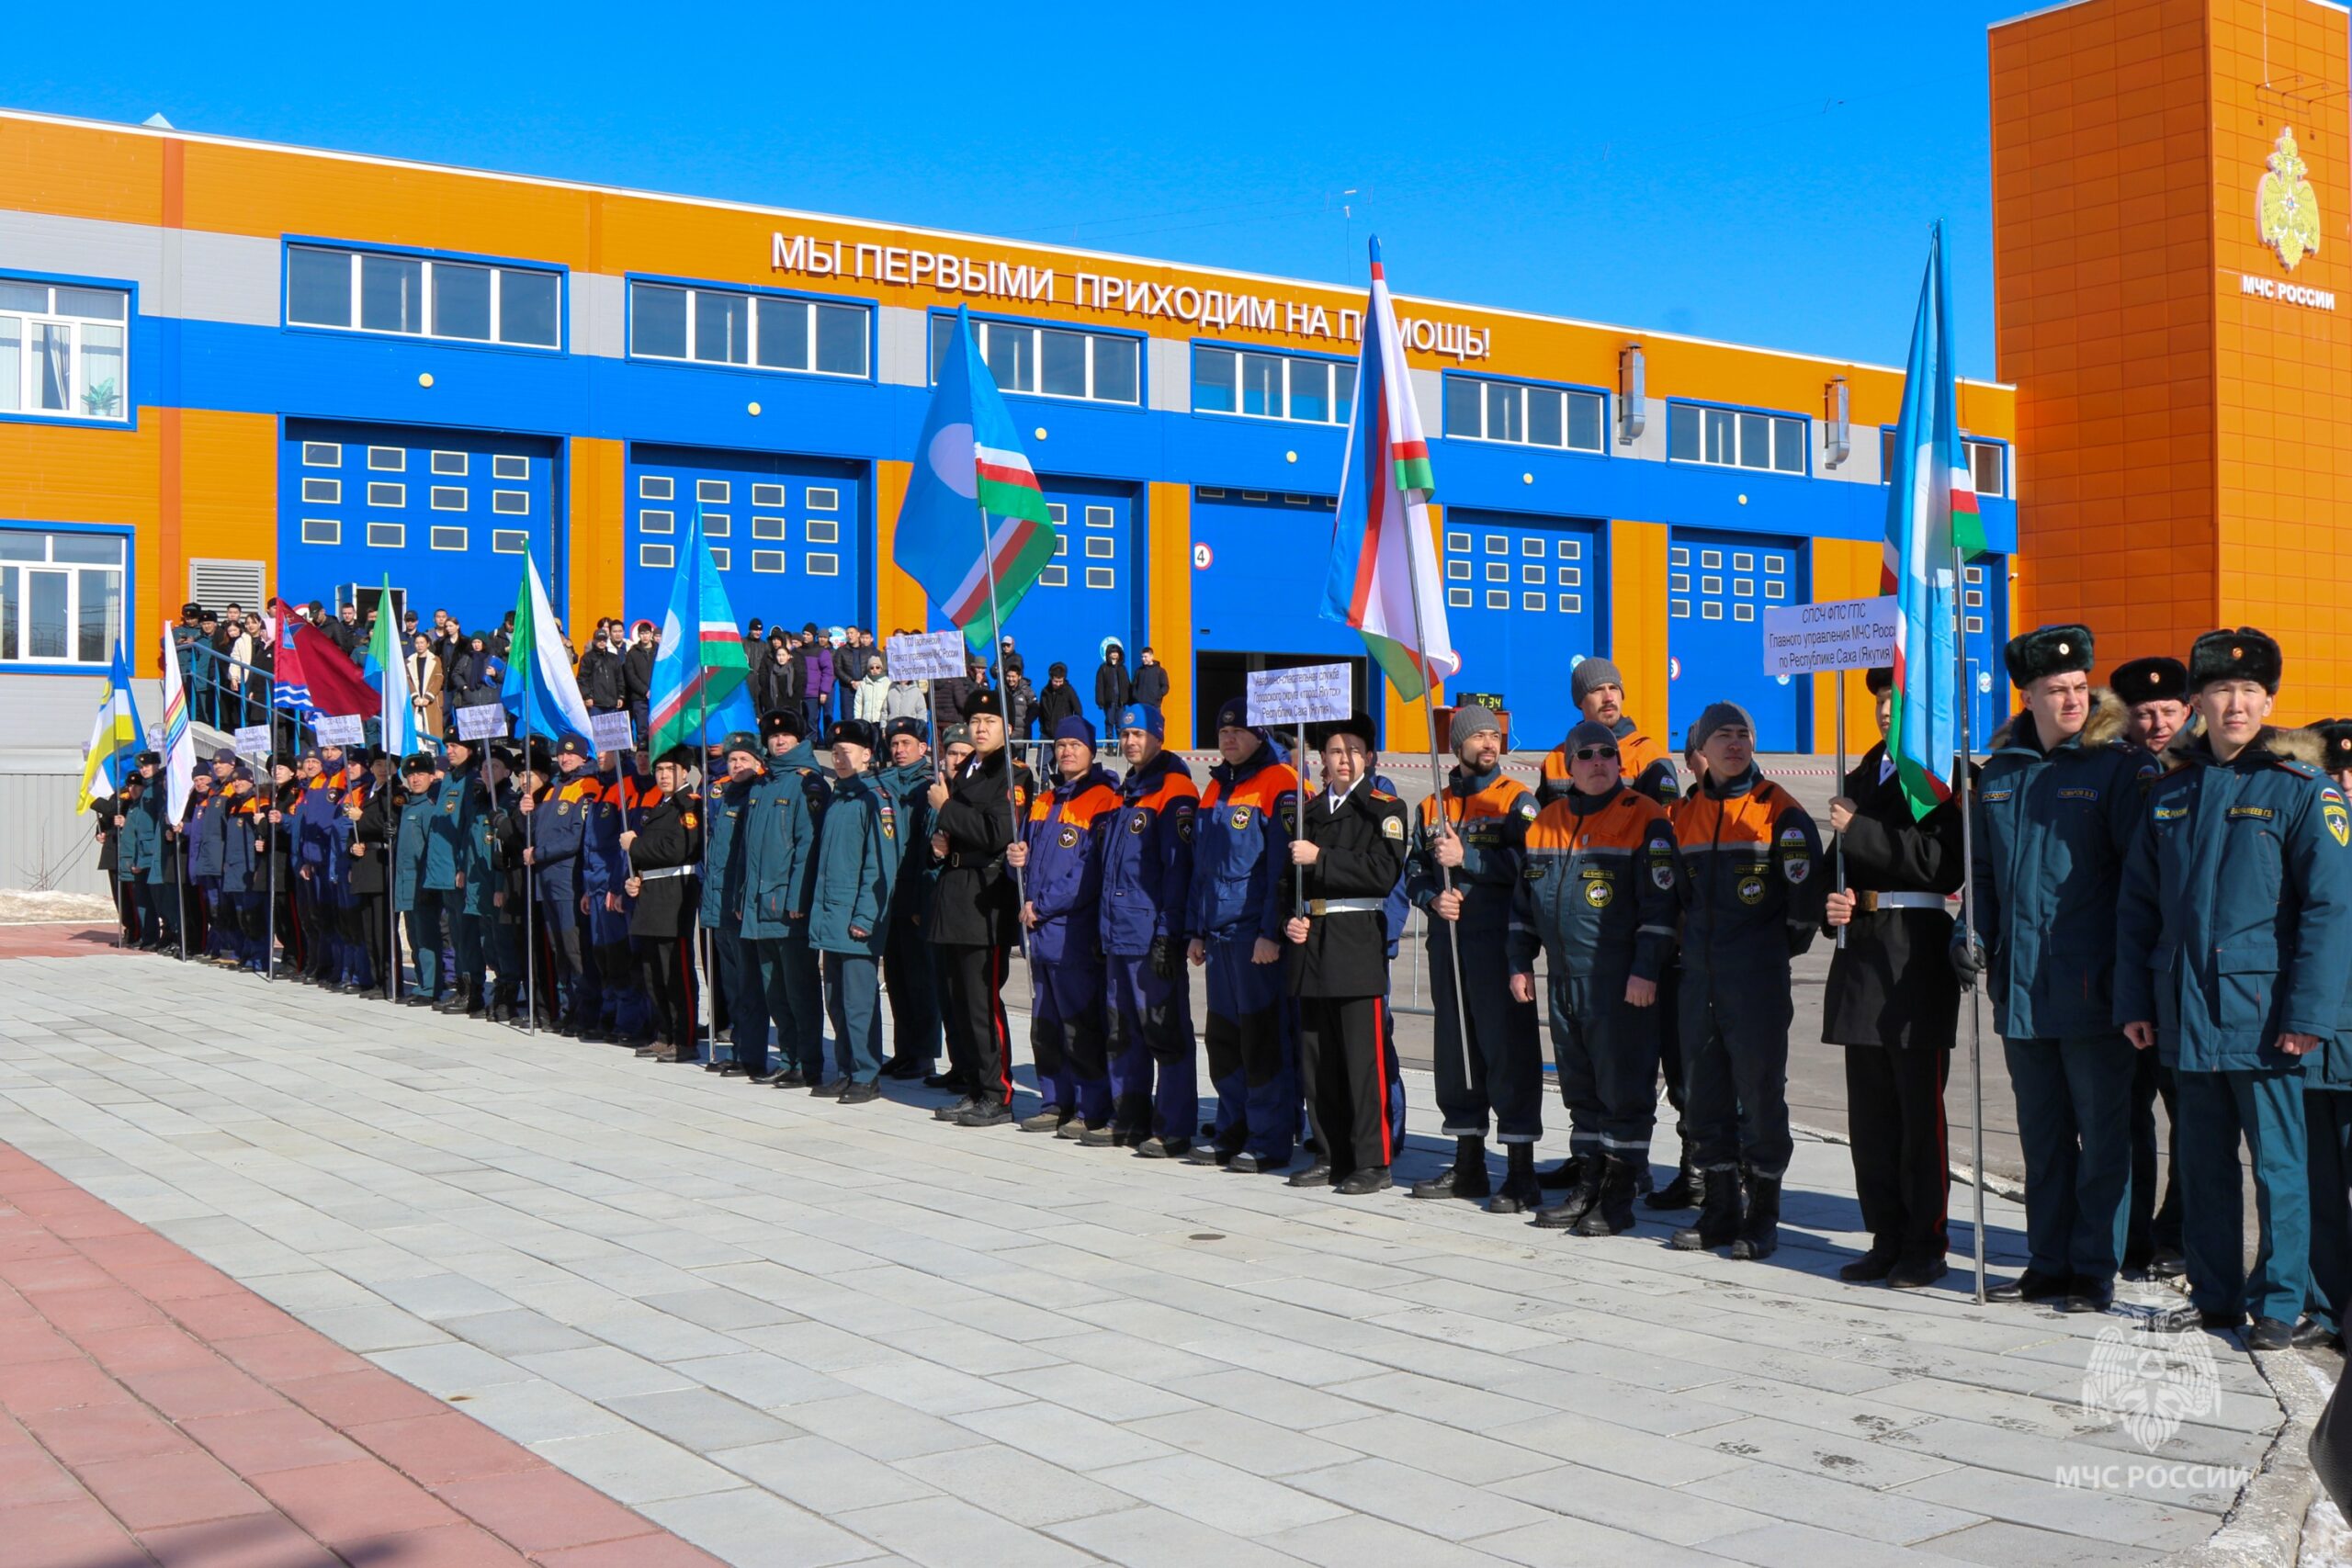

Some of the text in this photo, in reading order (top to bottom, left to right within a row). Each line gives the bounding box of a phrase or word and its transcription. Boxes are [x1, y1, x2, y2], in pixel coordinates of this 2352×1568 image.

[772, 232, 842, 276] МЫ
[854, 243, 1054, 301] ПЕРВЫМИ
[1075, 273, 1276, 330] ПРИХОДИМ
[1287, 301, 1331, 337] НА
[2242, 276, 2335, 310] МЧС РОССИИ
[1197, 549, 1205, 563] 4
[1803, 603, 1866, 624] СПСЧ ФПС ГПС
[1770, 624, 1896, 649] Главного управления МЧС Росс
[1779, 644, 1894, 670] по Республике Саха (Якутия)
[1294, 705, 1307, 717] Саха
